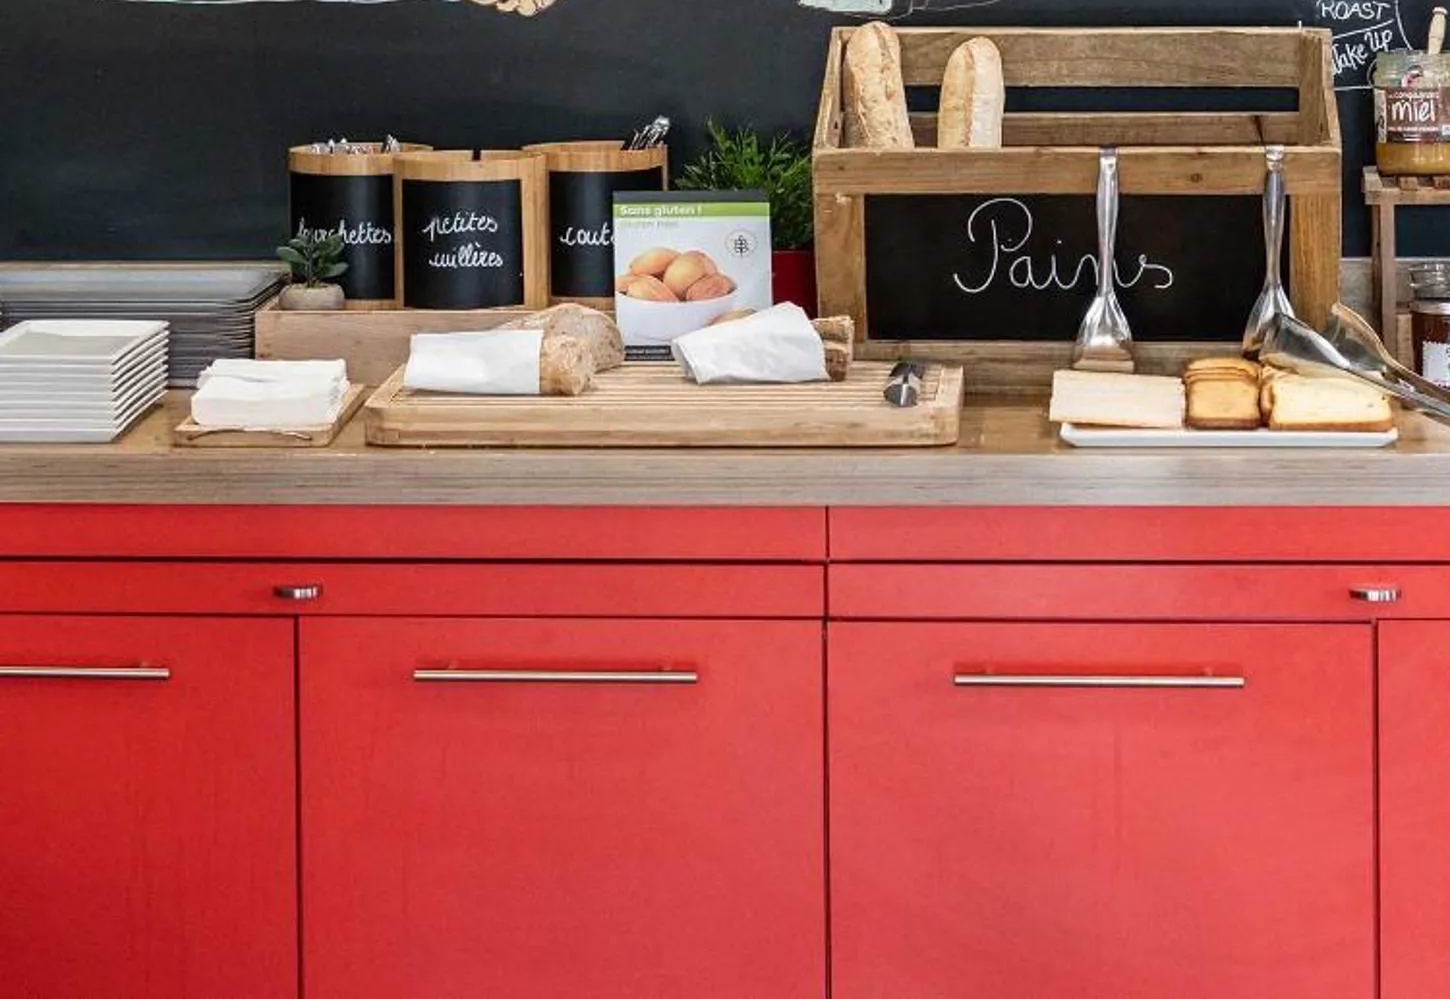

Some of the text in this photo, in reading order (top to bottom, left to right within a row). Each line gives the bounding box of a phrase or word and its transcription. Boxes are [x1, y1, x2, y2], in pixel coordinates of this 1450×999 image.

[421, 211, 498, 242] petites
[560, 221, 615, 246] cout
[953, 197, 1174, 293] Pains
